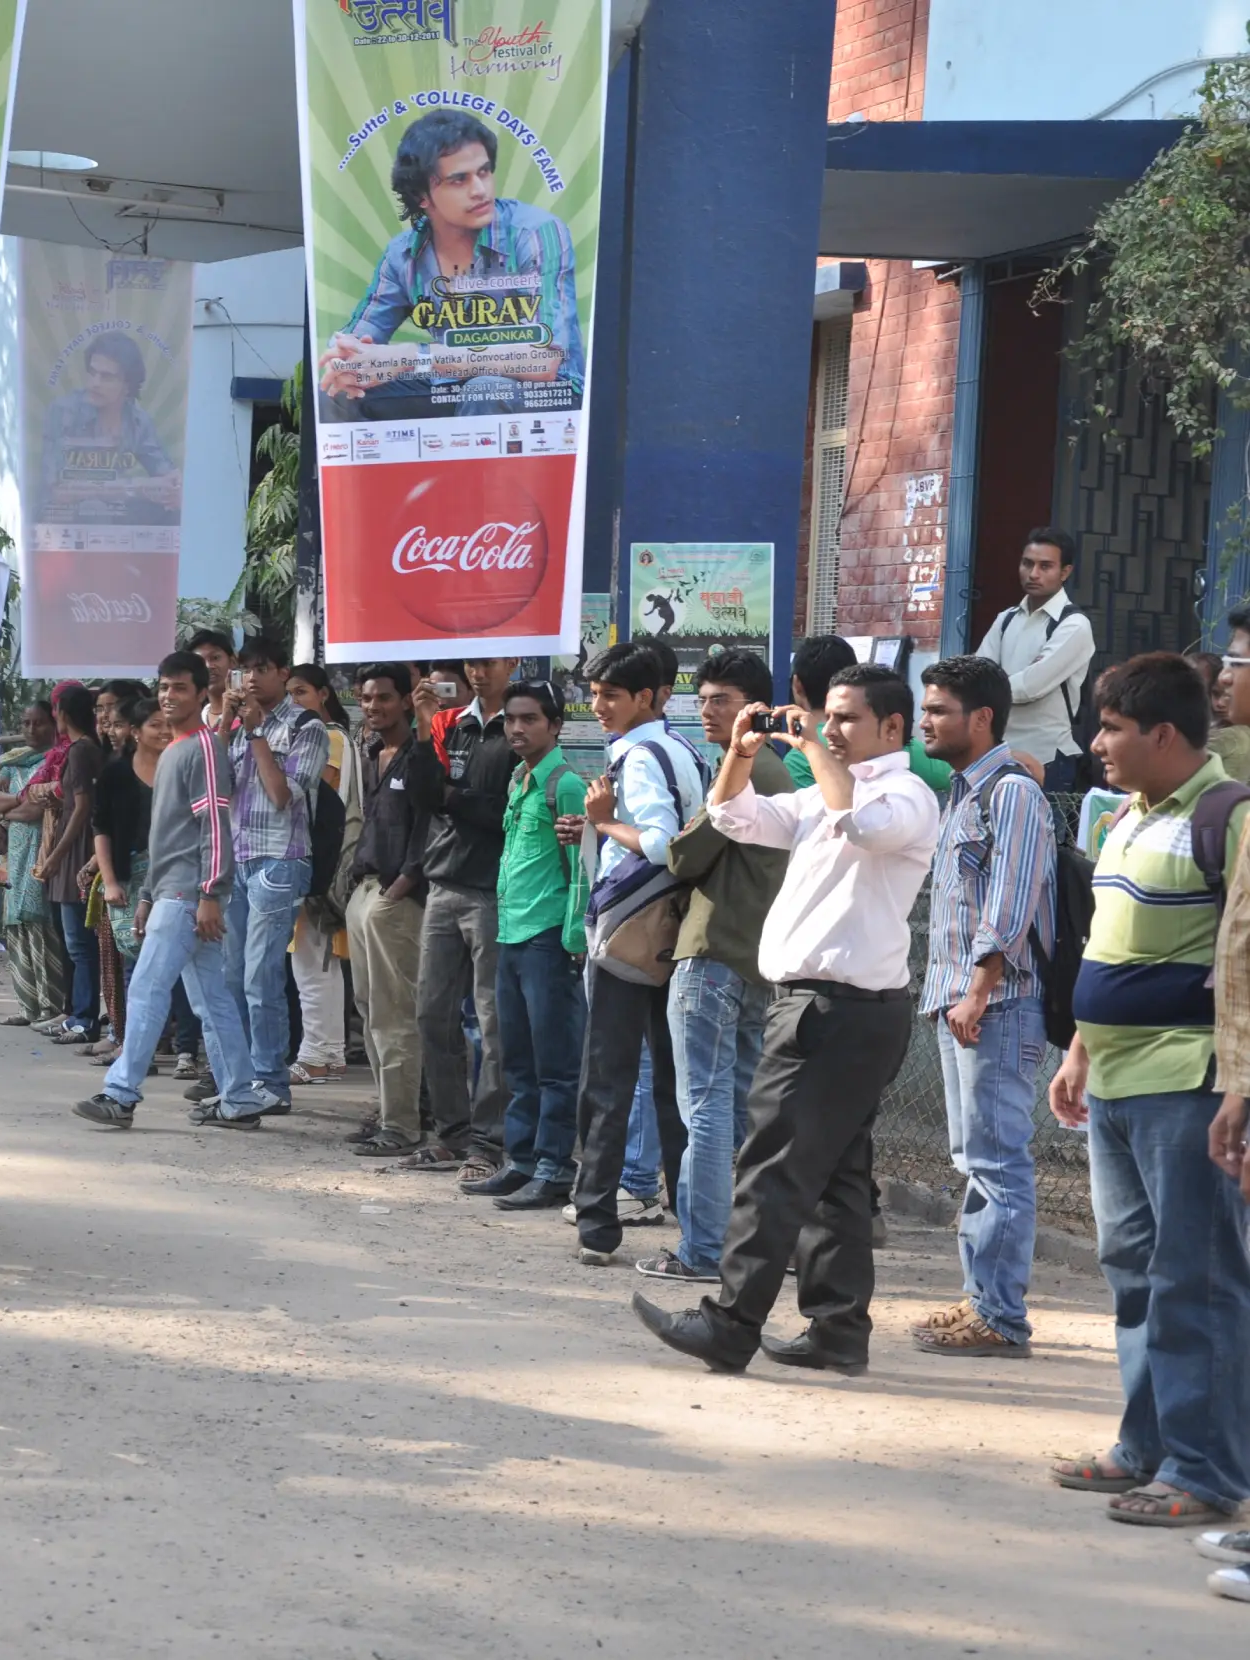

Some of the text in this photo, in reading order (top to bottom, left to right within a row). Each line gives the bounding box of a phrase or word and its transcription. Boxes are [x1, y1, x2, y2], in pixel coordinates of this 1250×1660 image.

[493, 42, 553, 58] festival of
[394, 101, 408, 115] &
[532, 148, 564, 193] FAME
[412, 294, 543, 328] GAURAV
[453, 329, 535, 345] DAGAONKAR
[400, 356, 432, 367] Raman
[431, 394, 466, 405] CONTACT
[467, 393, 484, 402] FOR
[485, 391, 514, 402] PASSES
[915, 479, 935, 493] ABVP
[392, 521, 541, 574] Coca-Cola
